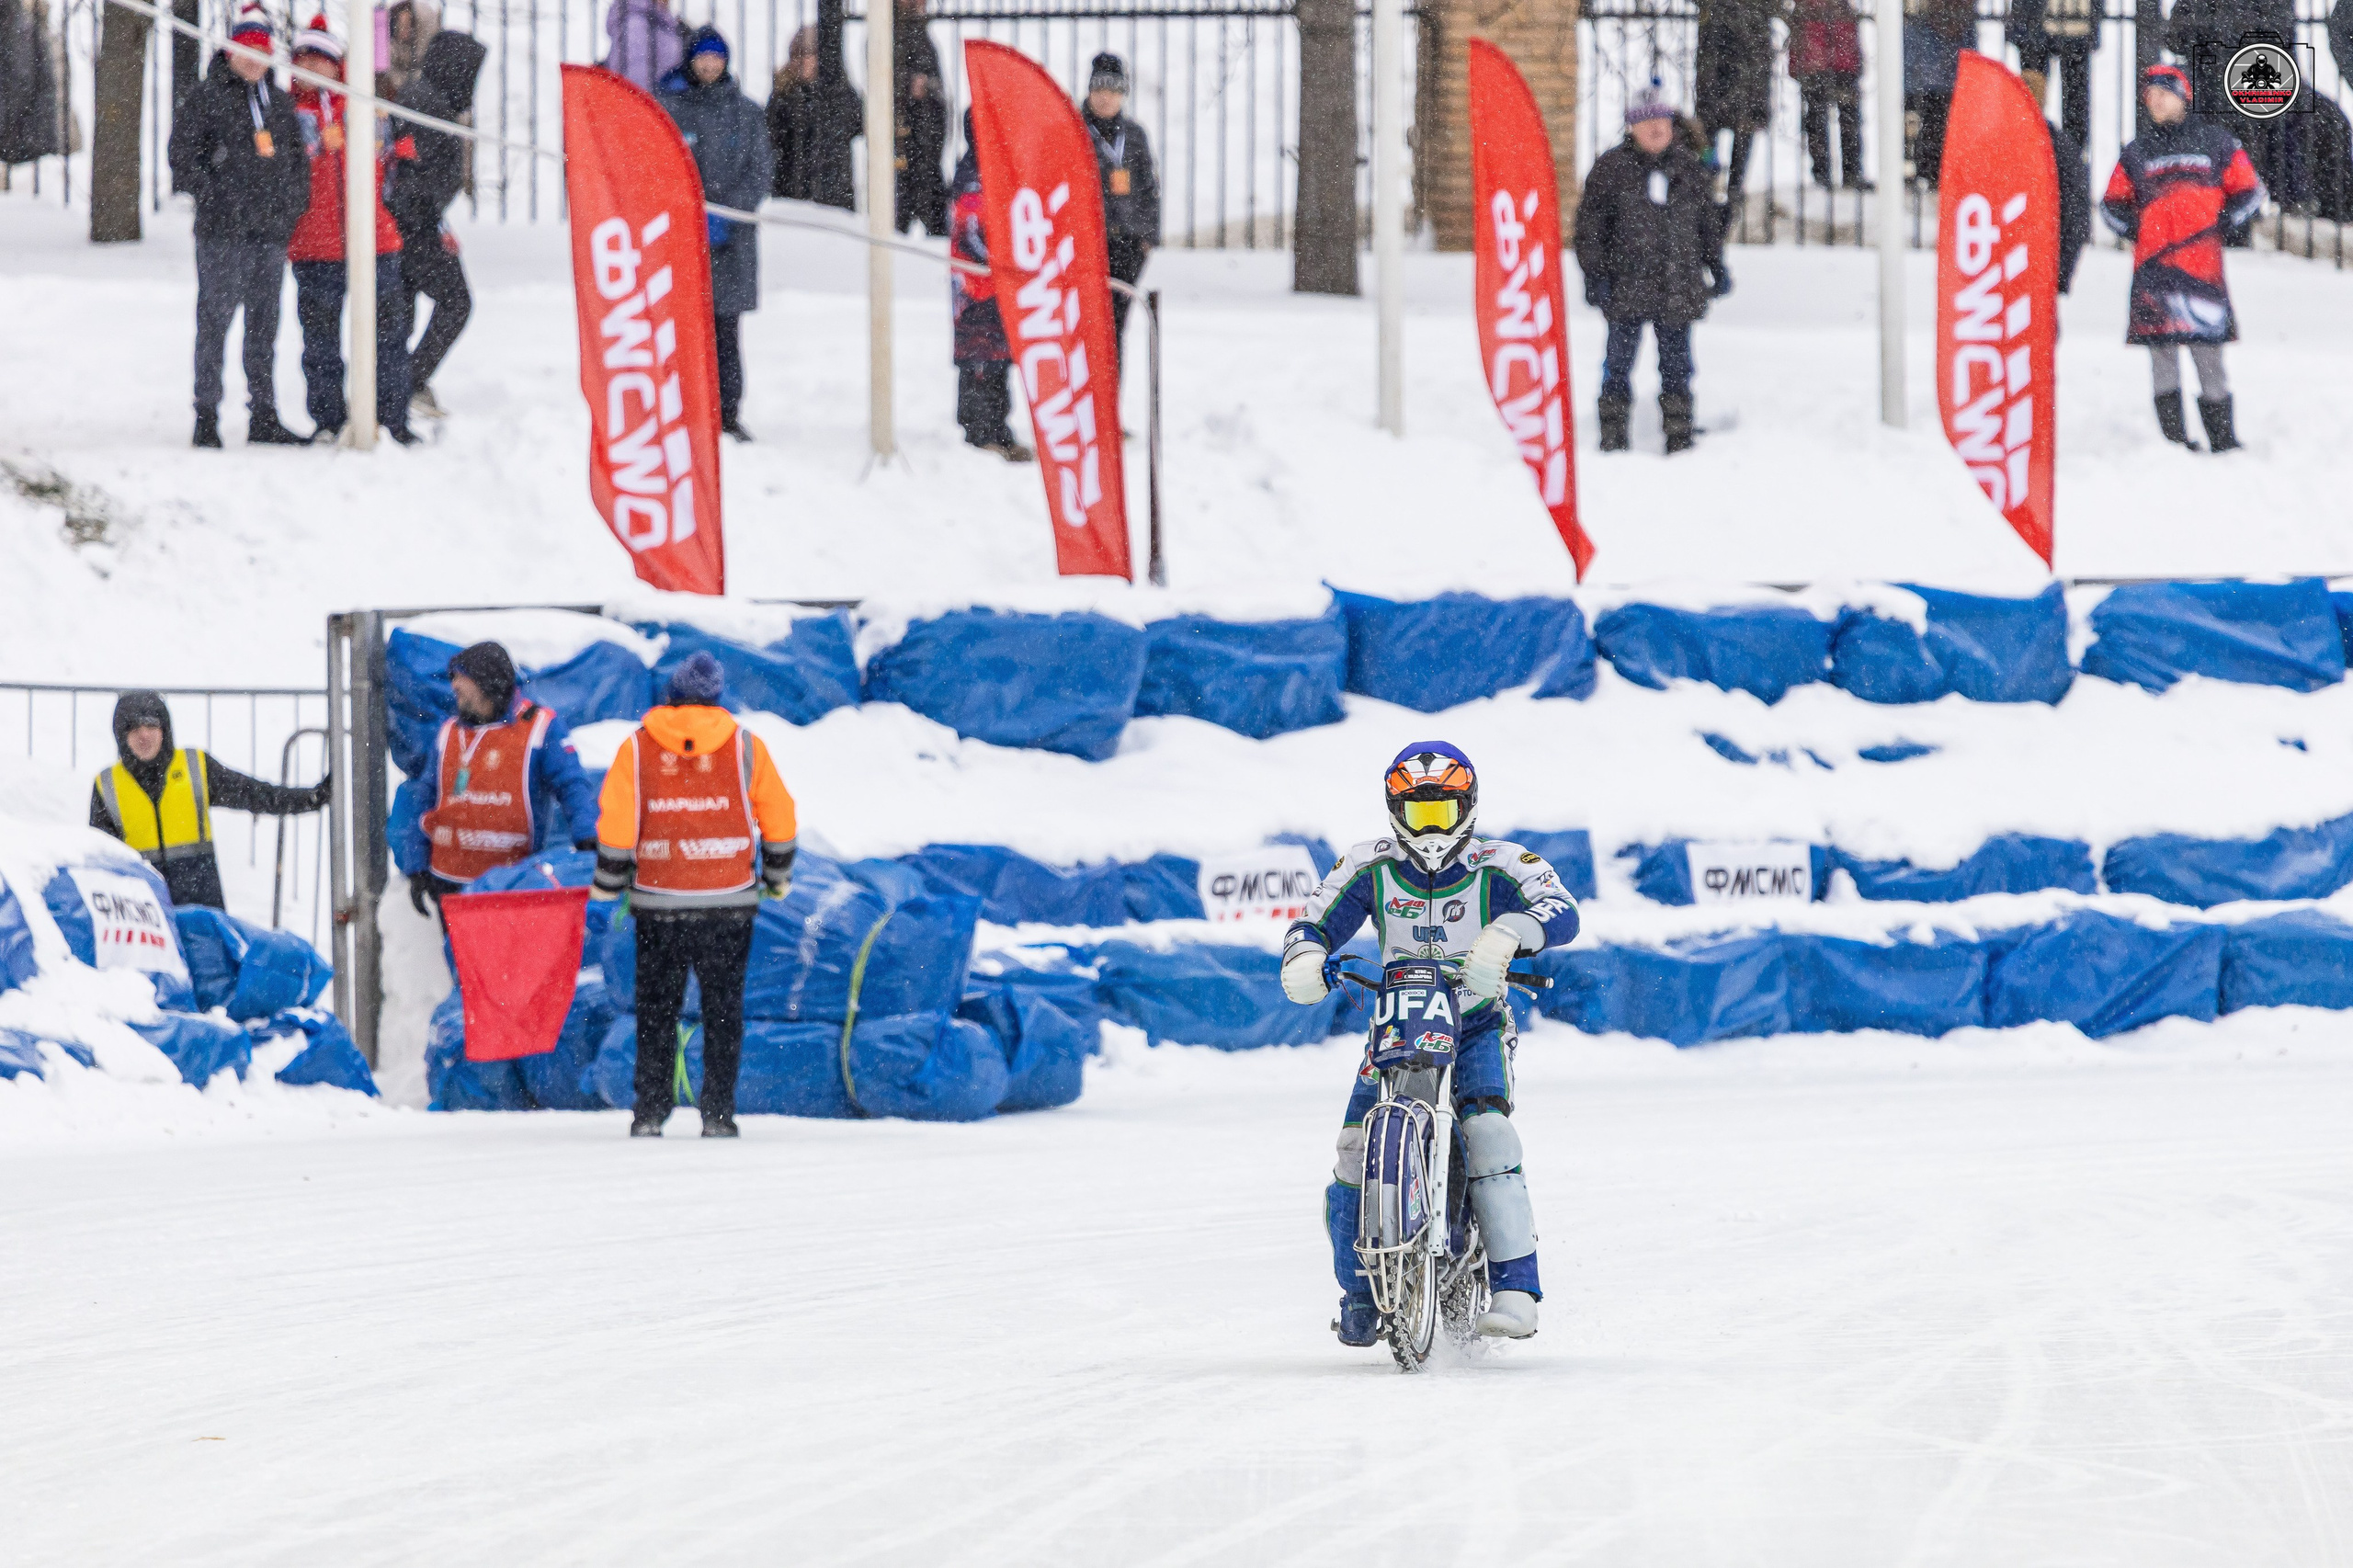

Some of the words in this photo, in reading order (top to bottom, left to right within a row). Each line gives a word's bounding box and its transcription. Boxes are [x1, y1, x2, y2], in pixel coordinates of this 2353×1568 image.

[647, 796, 730, 812] МАРШАЛ
[1525, 898, 1571, 923] UFA
[1413, 925, 1448, 943] UFA
[1376, 990, 1454, 1027] UFA
